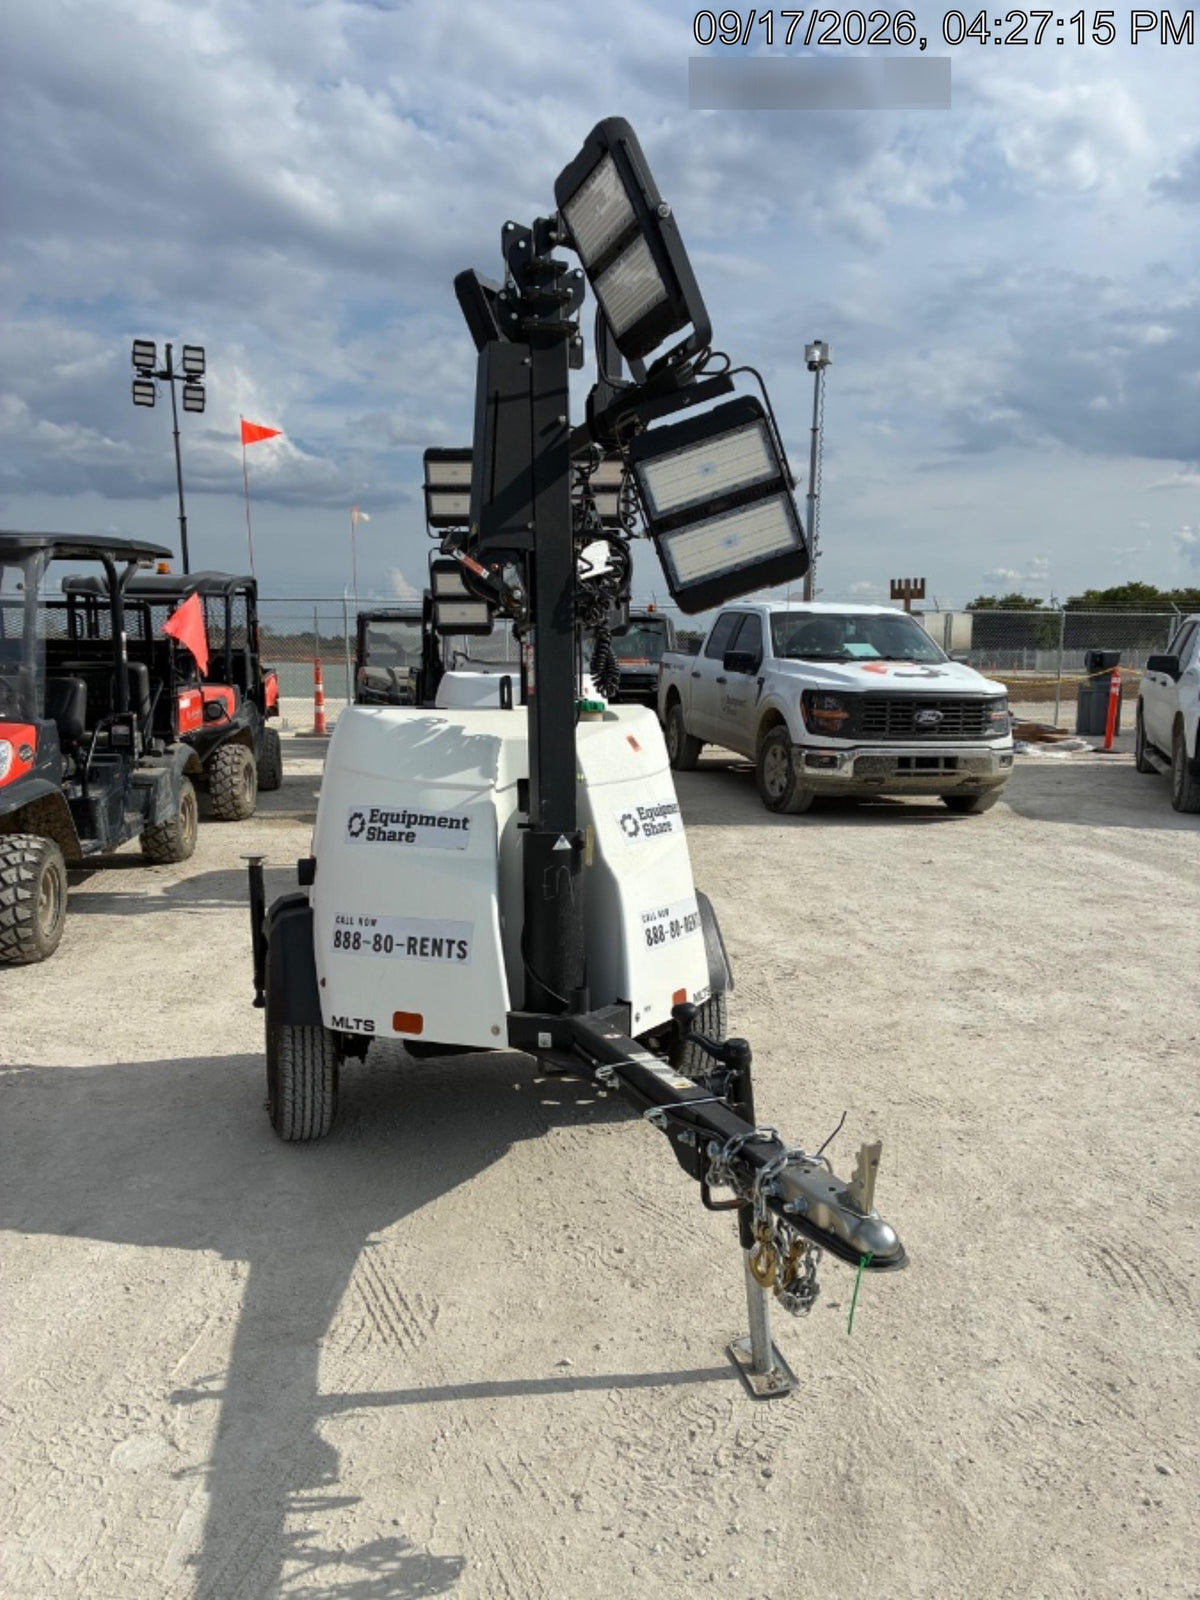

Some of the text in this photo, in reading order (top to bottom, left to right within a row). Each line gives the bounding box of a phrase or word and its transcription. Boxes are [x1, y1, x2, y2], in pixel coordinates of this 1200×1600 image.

[368, 808, 470, 831] Equipment
[366, 826, 416, 843] Share
[642, 821, 672, 837] Share
[335, 914, 378, 927] CALL NOW
[333, 930, 468, 960] 888-80-RENTS
[331, 1015, 375, 1032] MLTS
